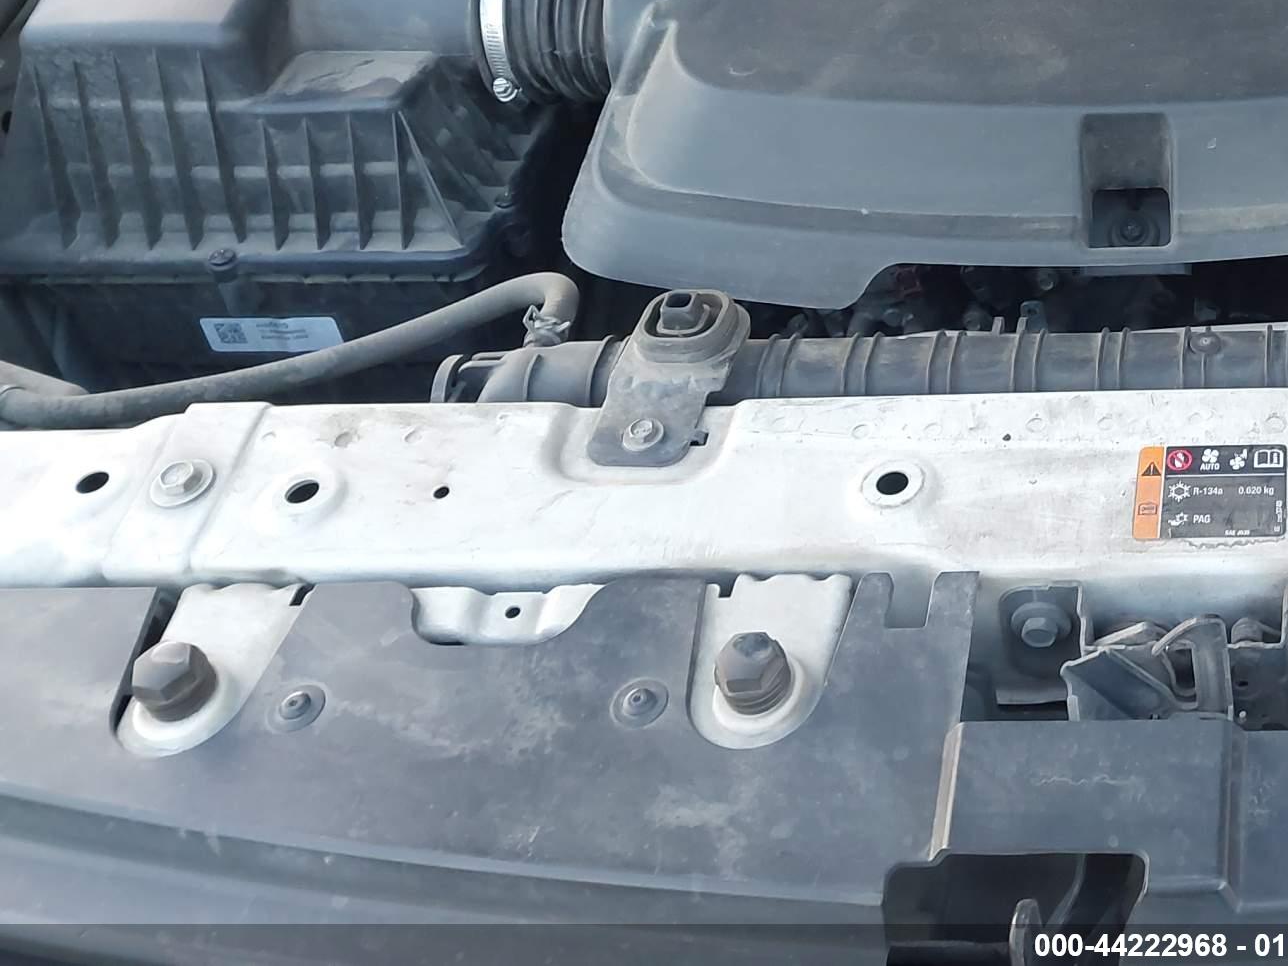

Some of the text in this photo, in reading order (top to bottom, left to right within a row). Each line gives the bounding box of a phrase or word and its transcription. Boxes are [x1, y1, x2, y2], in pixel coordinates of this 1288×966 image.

[1200, 462, 1220, 471] AUTO
[1192, 486, 1223, 496] R-134a
[1263, 485, 1275, 496] kg
[1192, 513, 1212, 524] PAG
